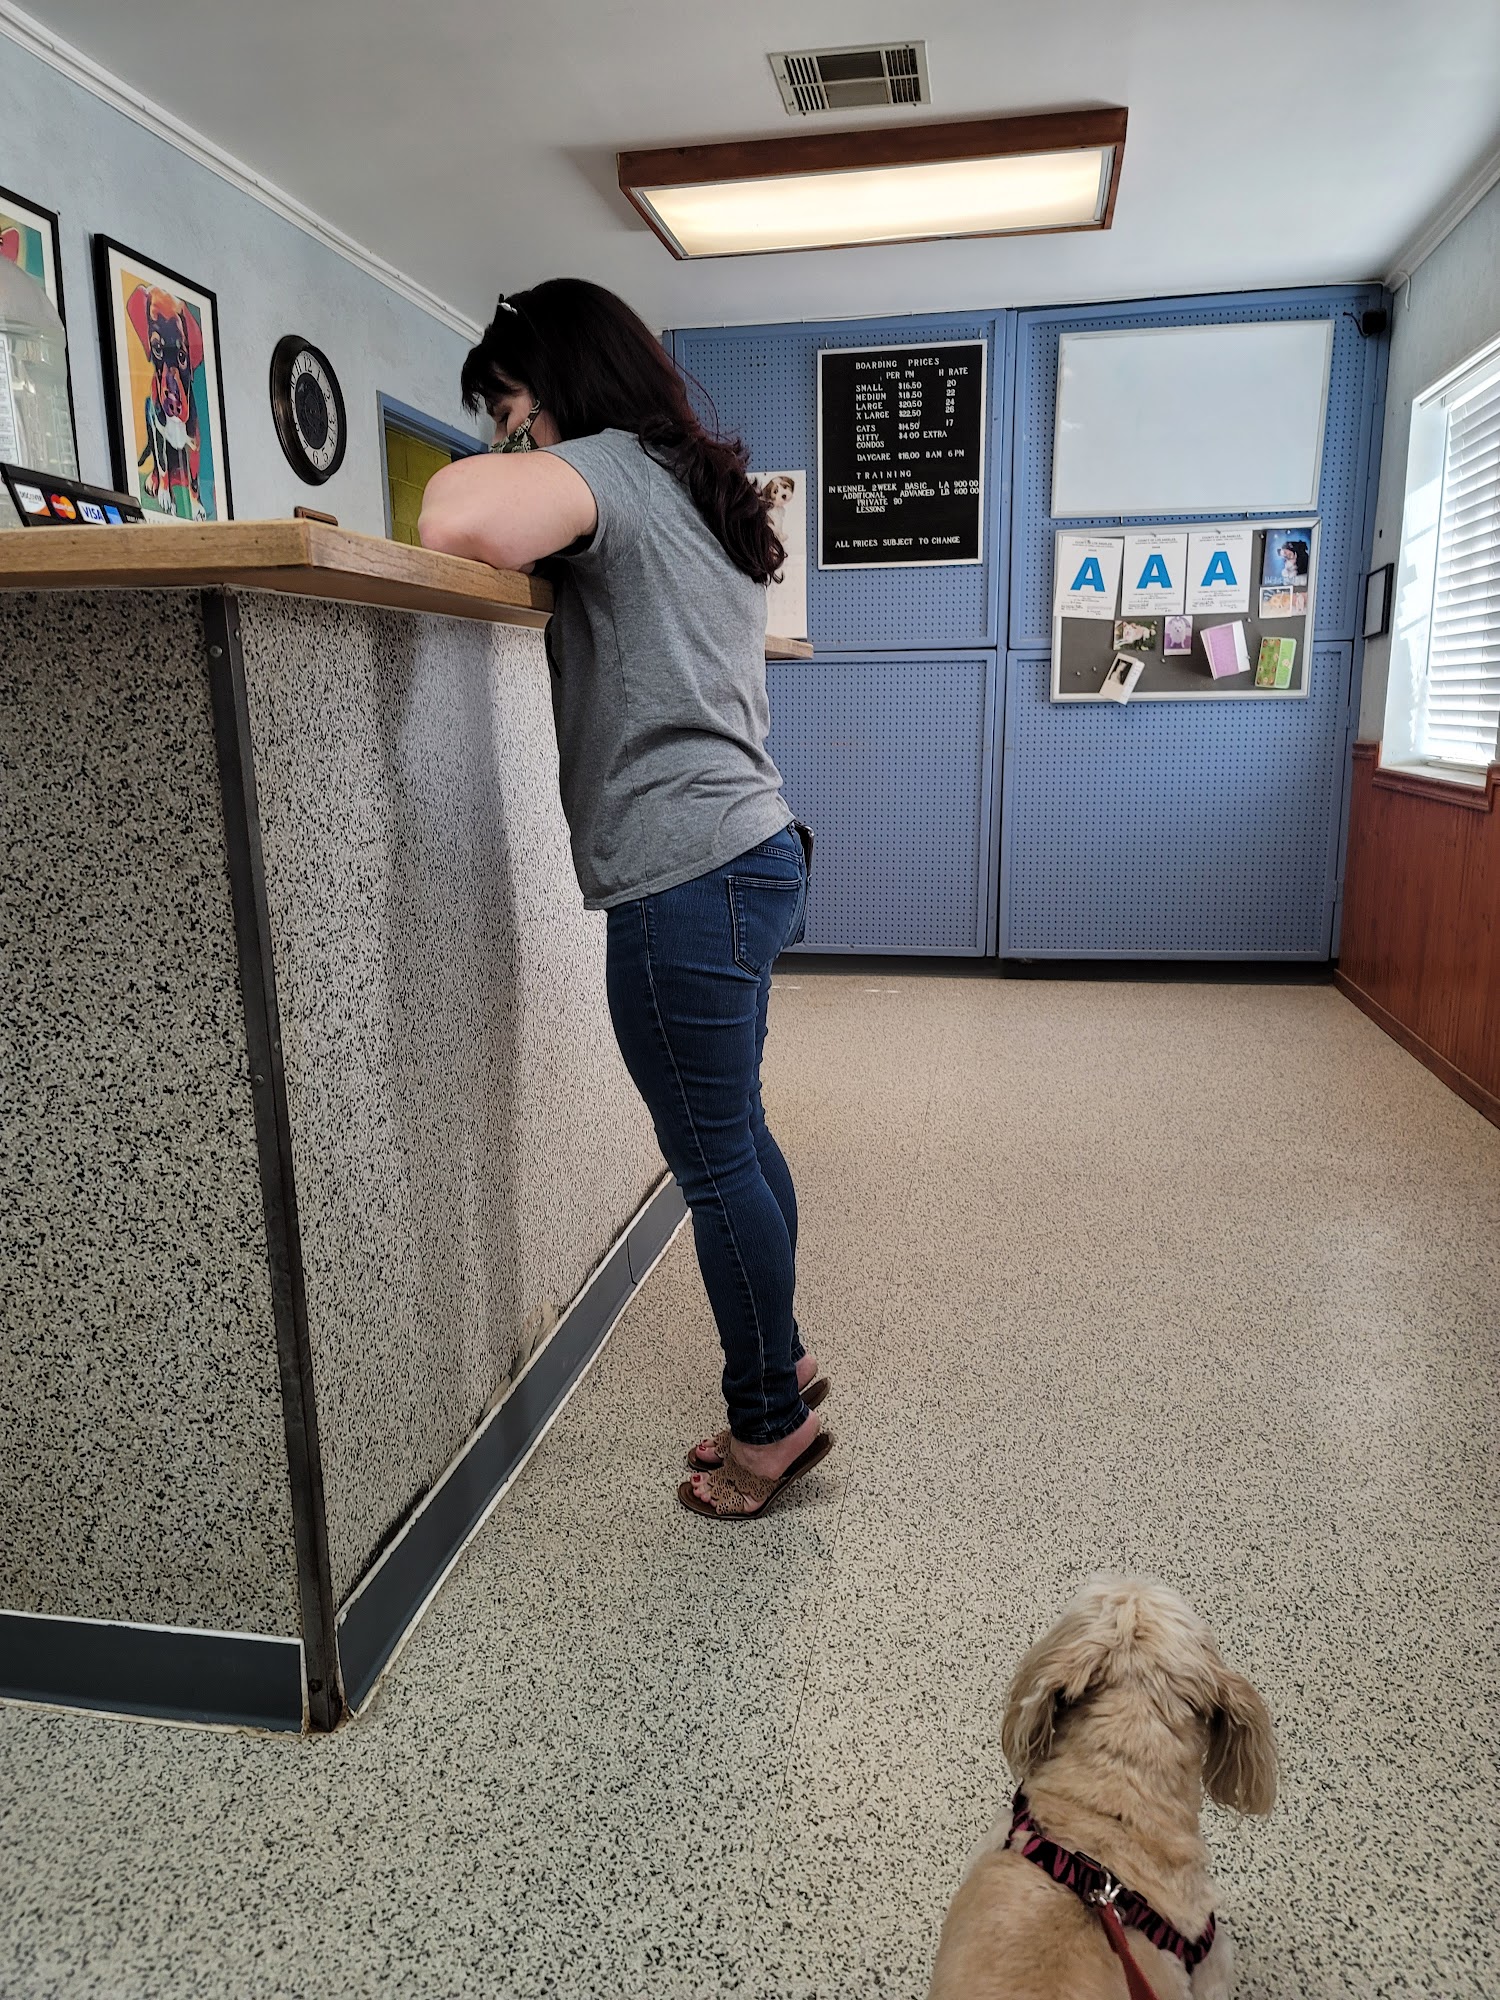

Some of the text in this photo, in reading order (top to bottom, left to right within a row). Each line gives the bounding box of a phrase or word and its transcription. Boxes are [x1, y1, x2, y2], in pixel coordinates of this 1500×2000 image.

[856, 358, 939, 370] BOARDING PRICES
[949, 367, 968, 375] RATE
[856, 384, 883, 392] SMALL
[947, 379, 956, 387] 20
[856, 393, 886, 401] MEDIUM
[856, 402, 883, 410] LARGE
[946, 398, 954, 406] 24
[856, 412, 861, 420] X
[864, 411, 889, 419] LARGE
[946, 405, 954, 413] 26
[857, 434, 879, 442] KITTY
[924, 430, 947, 438] EXTRA
[856, 440, 884, 449] CONDOS
[857, 453, 890, 461] DAYCARE
[857, 470, 911, 479] TRAINING
[837, 485, 867, 494] KENNEL
[905, 482, 928, 490] BASIC
[843, 491, 886, 500] ADDITIONAL
[900, 488, 935, 497] ADVANCED
[857, 498, 888, 506] PRIVATE
[82, 505, 105, 520] VISA
[835, 540, 850, 548] ALL
[883, 538, 913, 546] SUBJECT
[932, 536, 960, 544] CHANGE
[1070, 558, 1106, 592] A
[1136, 554, 1173, 590] A
[1200, 551, 1238, 587] A
